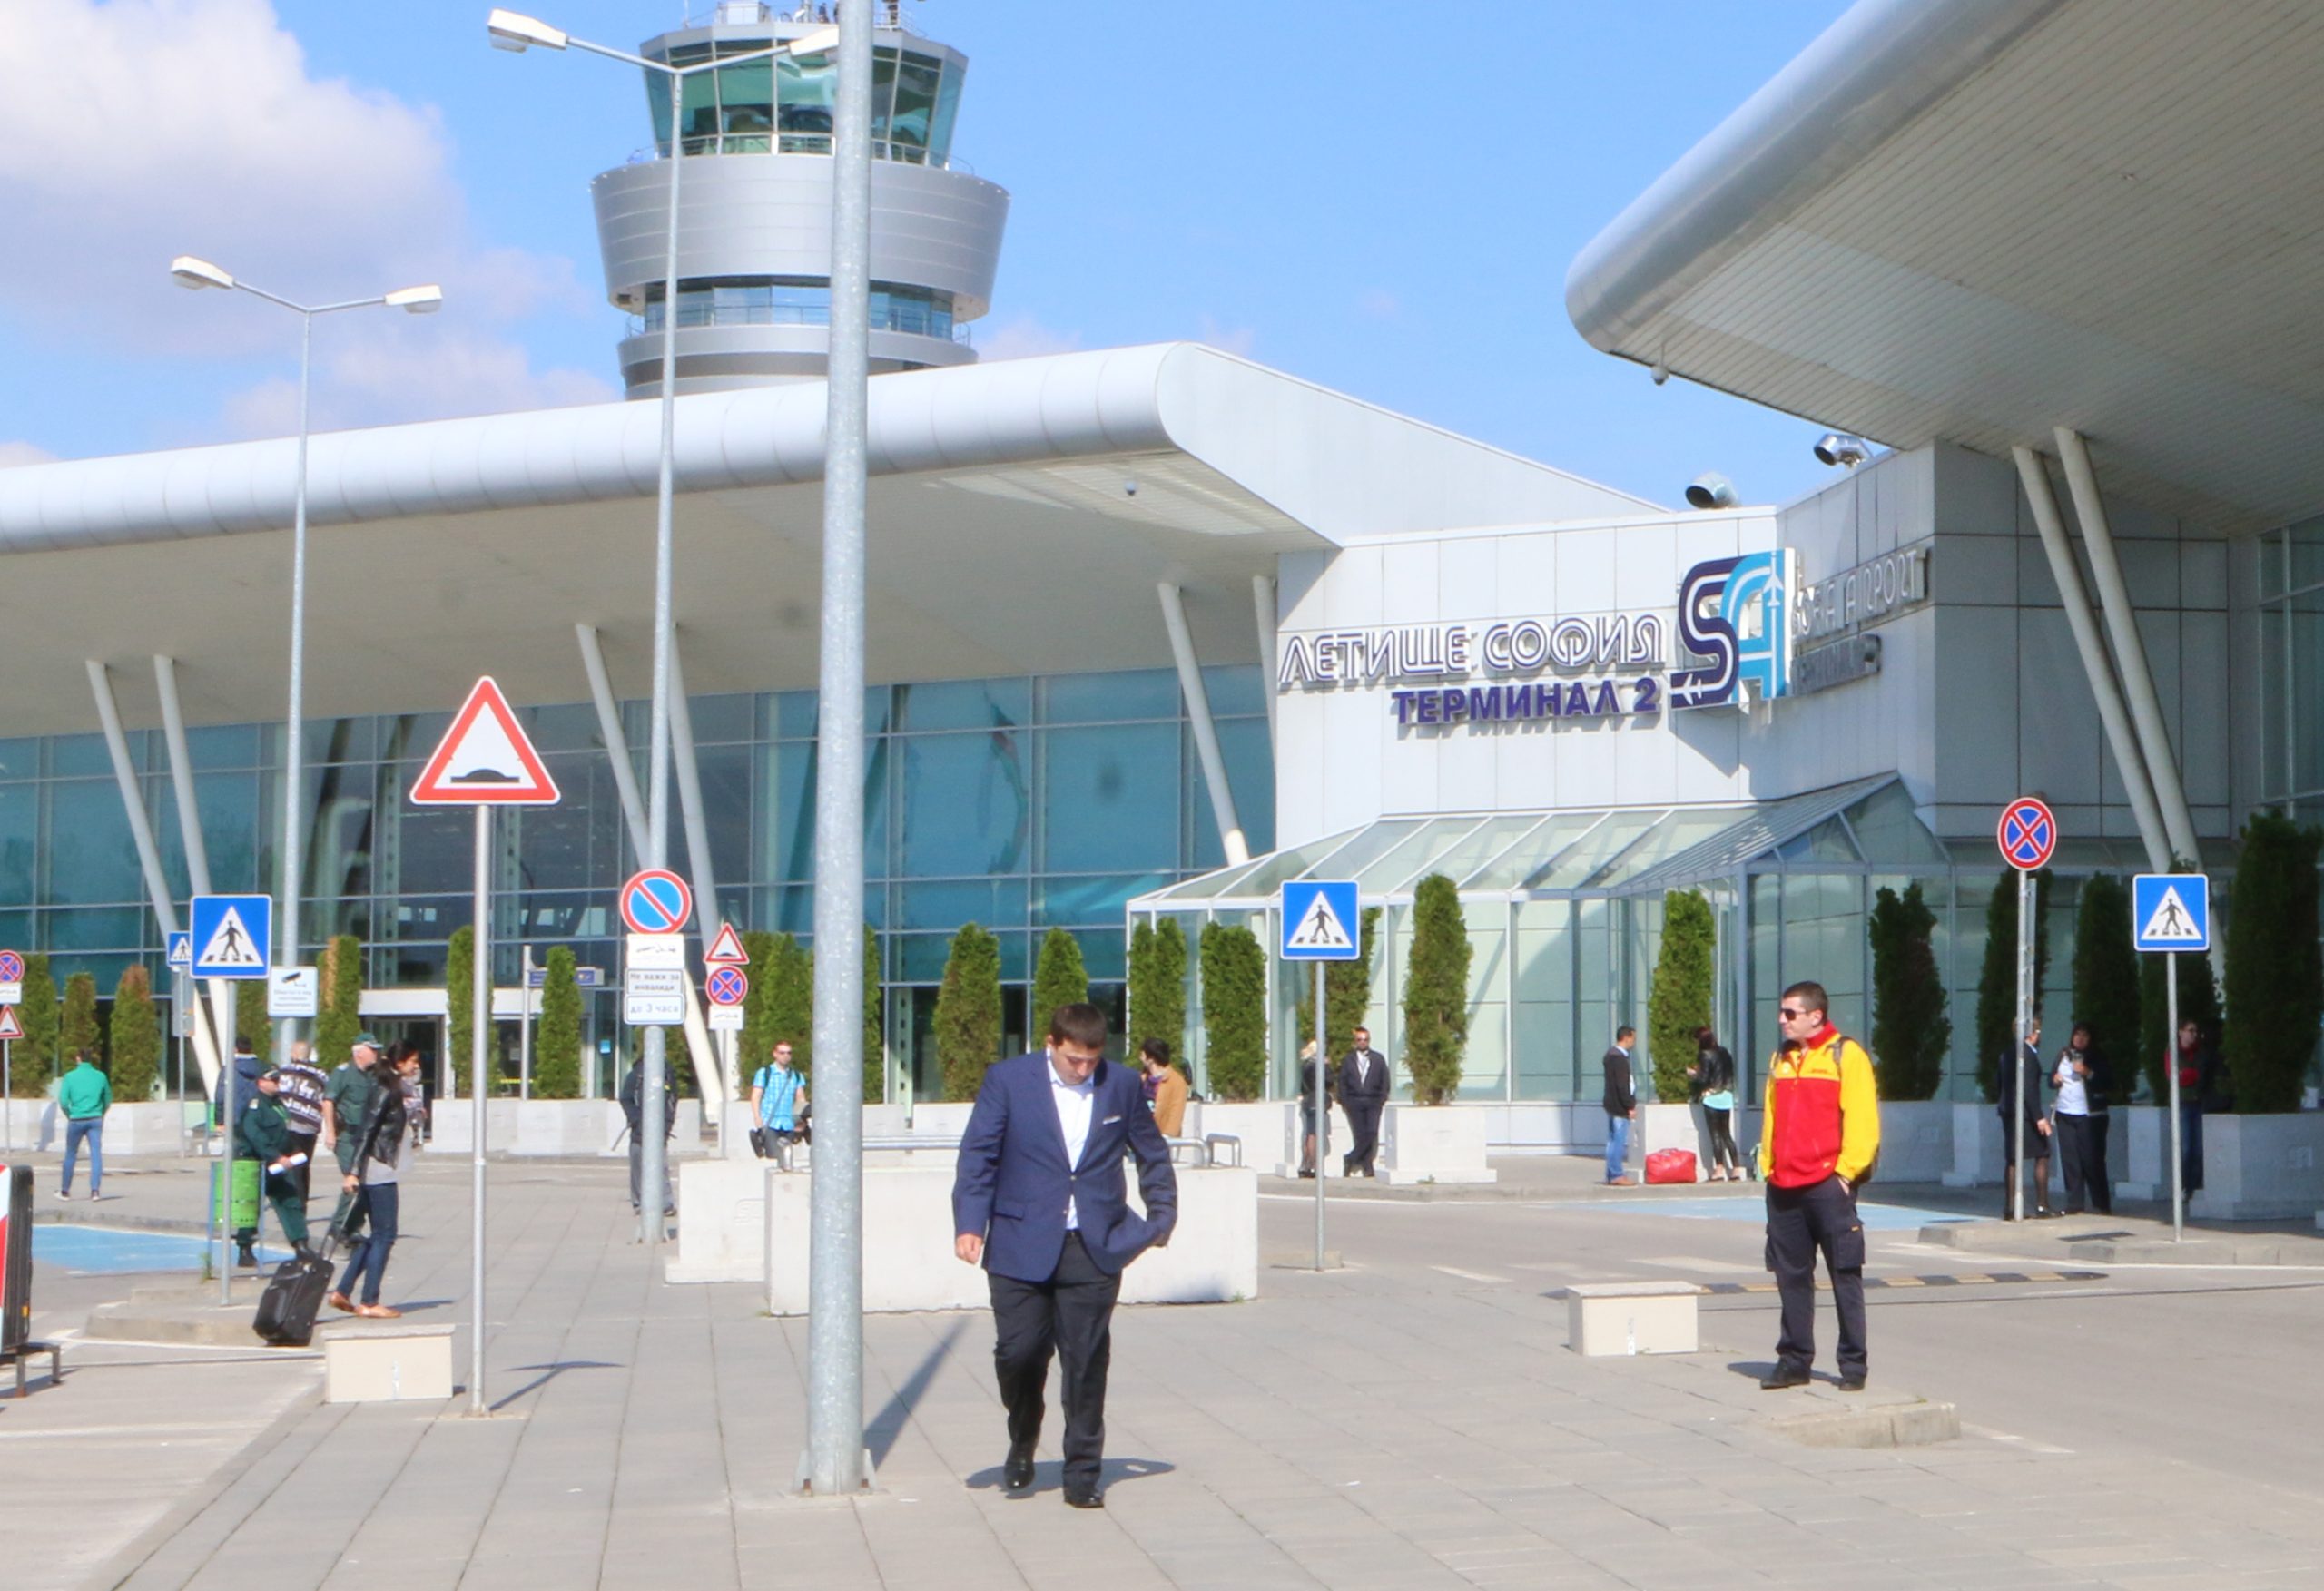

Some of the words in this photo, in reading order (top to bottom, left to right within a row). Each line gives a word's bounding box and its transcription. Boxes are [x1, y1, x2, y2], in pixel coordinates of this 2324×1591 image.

[1278, 626, 1470, 683] ЛЕТИЩЕ
[1483, 614, 1665, 671] СОФИЯ
[1391, 679, 1620, 724] ТЕРМИНАЛ
[1633, 677, 1658, 712] 2
[645, 1003, 653, 1013] 3
[655, 1005, 679, 1013] часа
